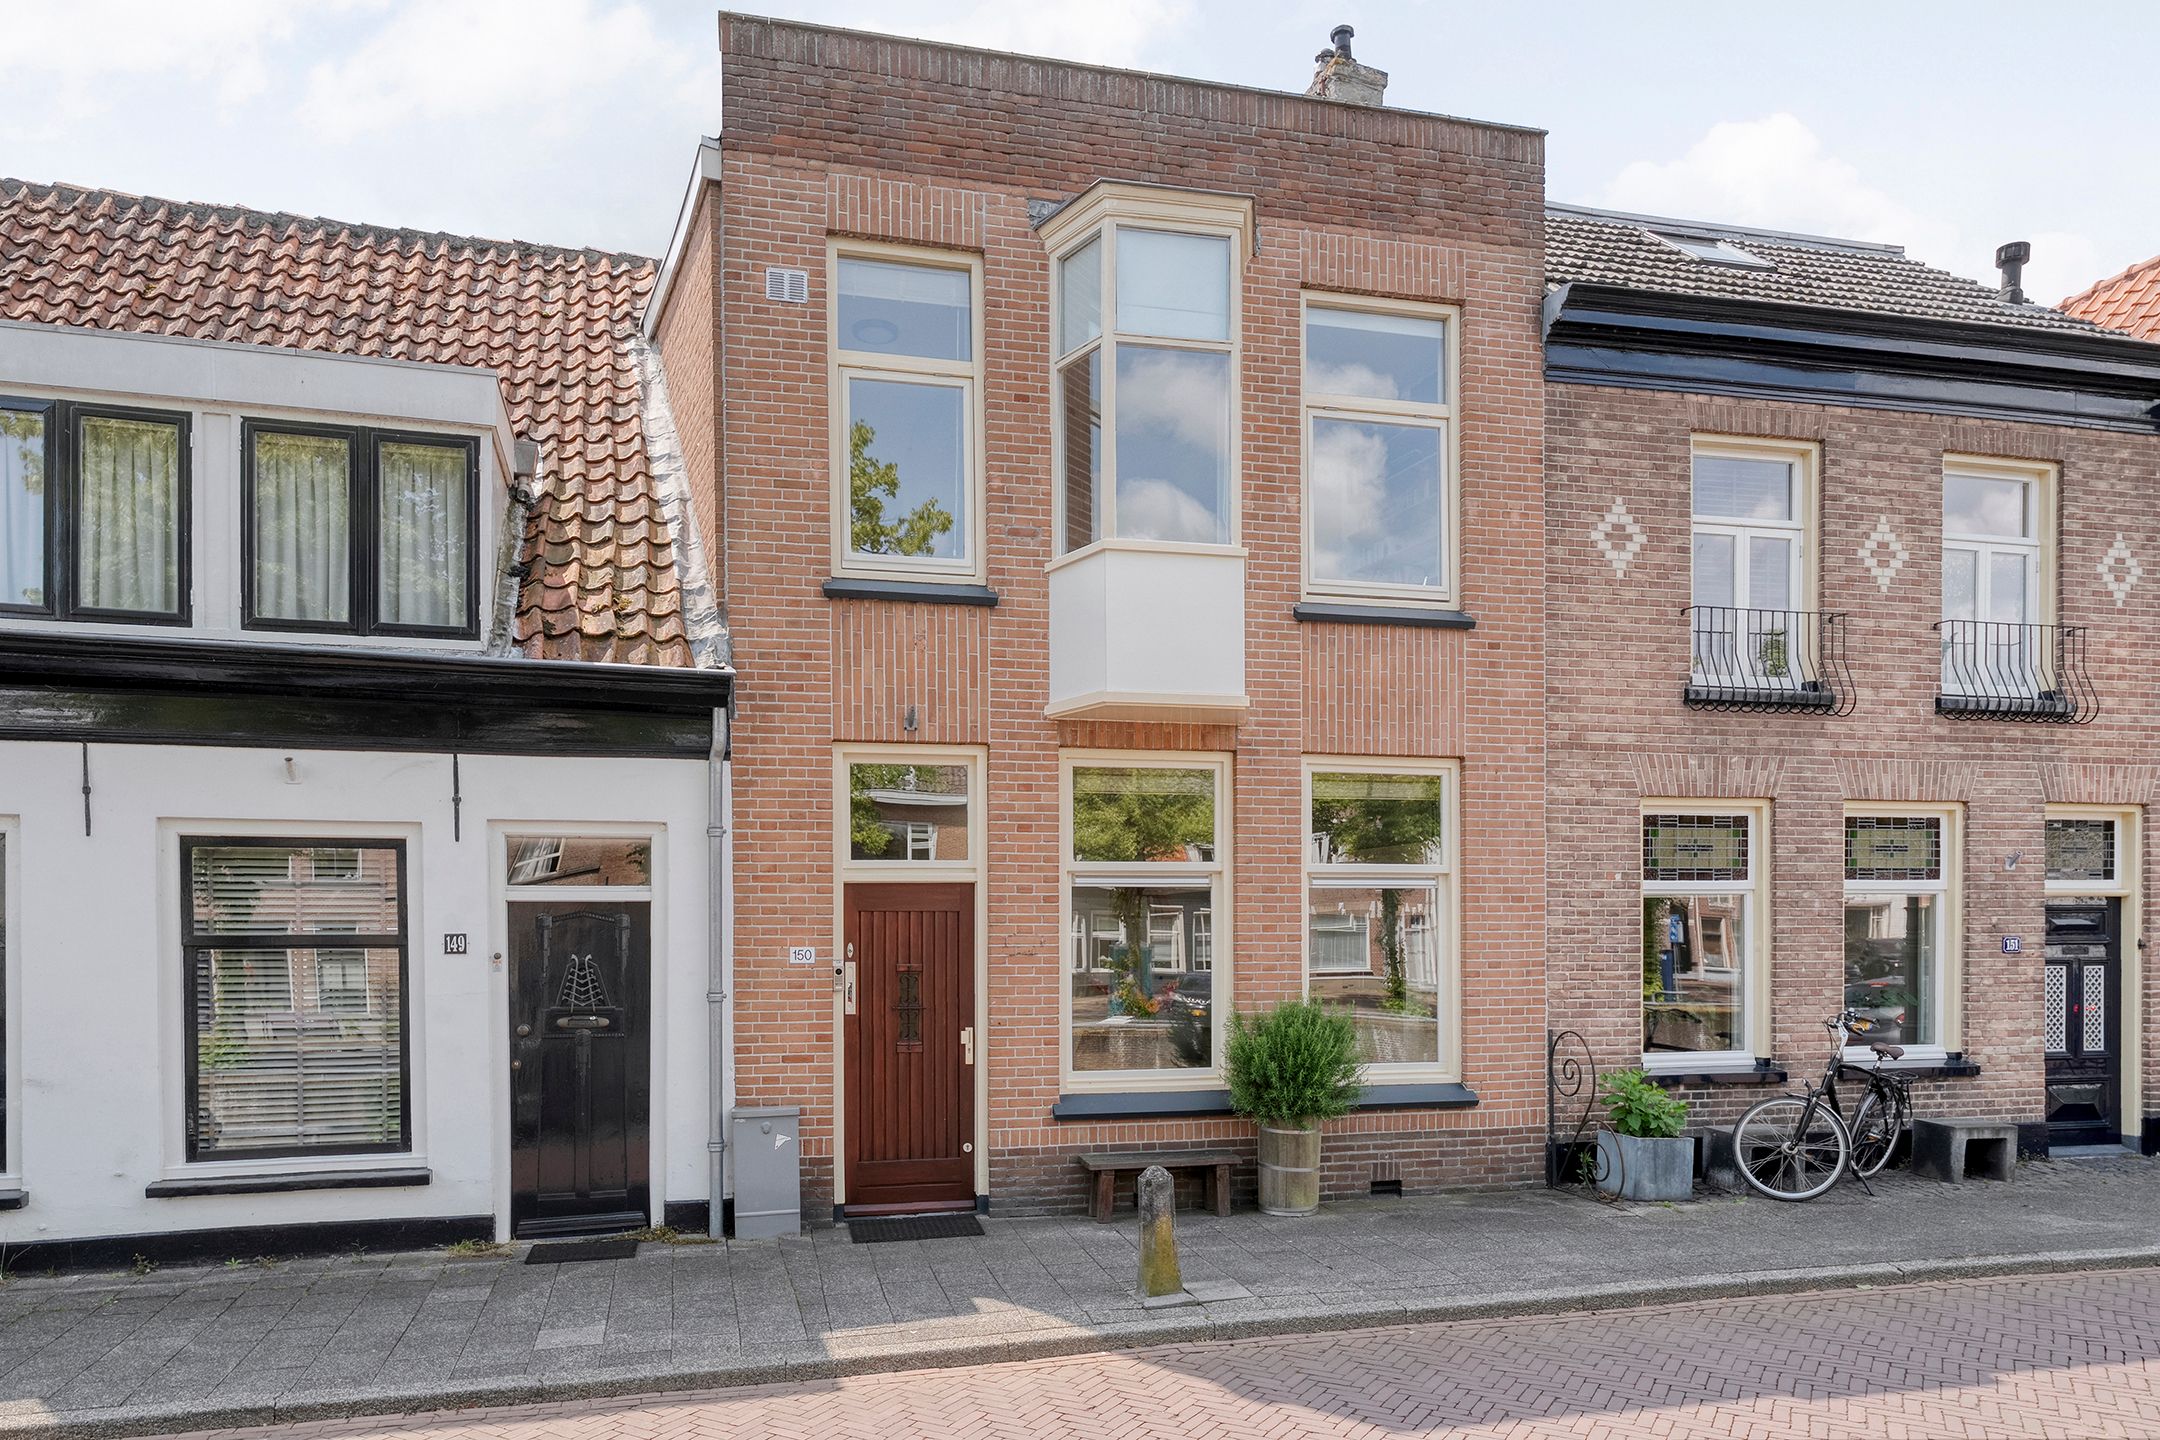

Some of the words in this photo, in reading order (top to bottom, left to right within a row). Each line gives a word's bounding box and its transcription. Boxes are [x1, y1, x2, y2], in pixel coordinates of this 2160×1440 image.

[446, 935, 465, 952] 149
[2005, 939, 2019, 951] 151
[792, 949, 812, 961] 150
